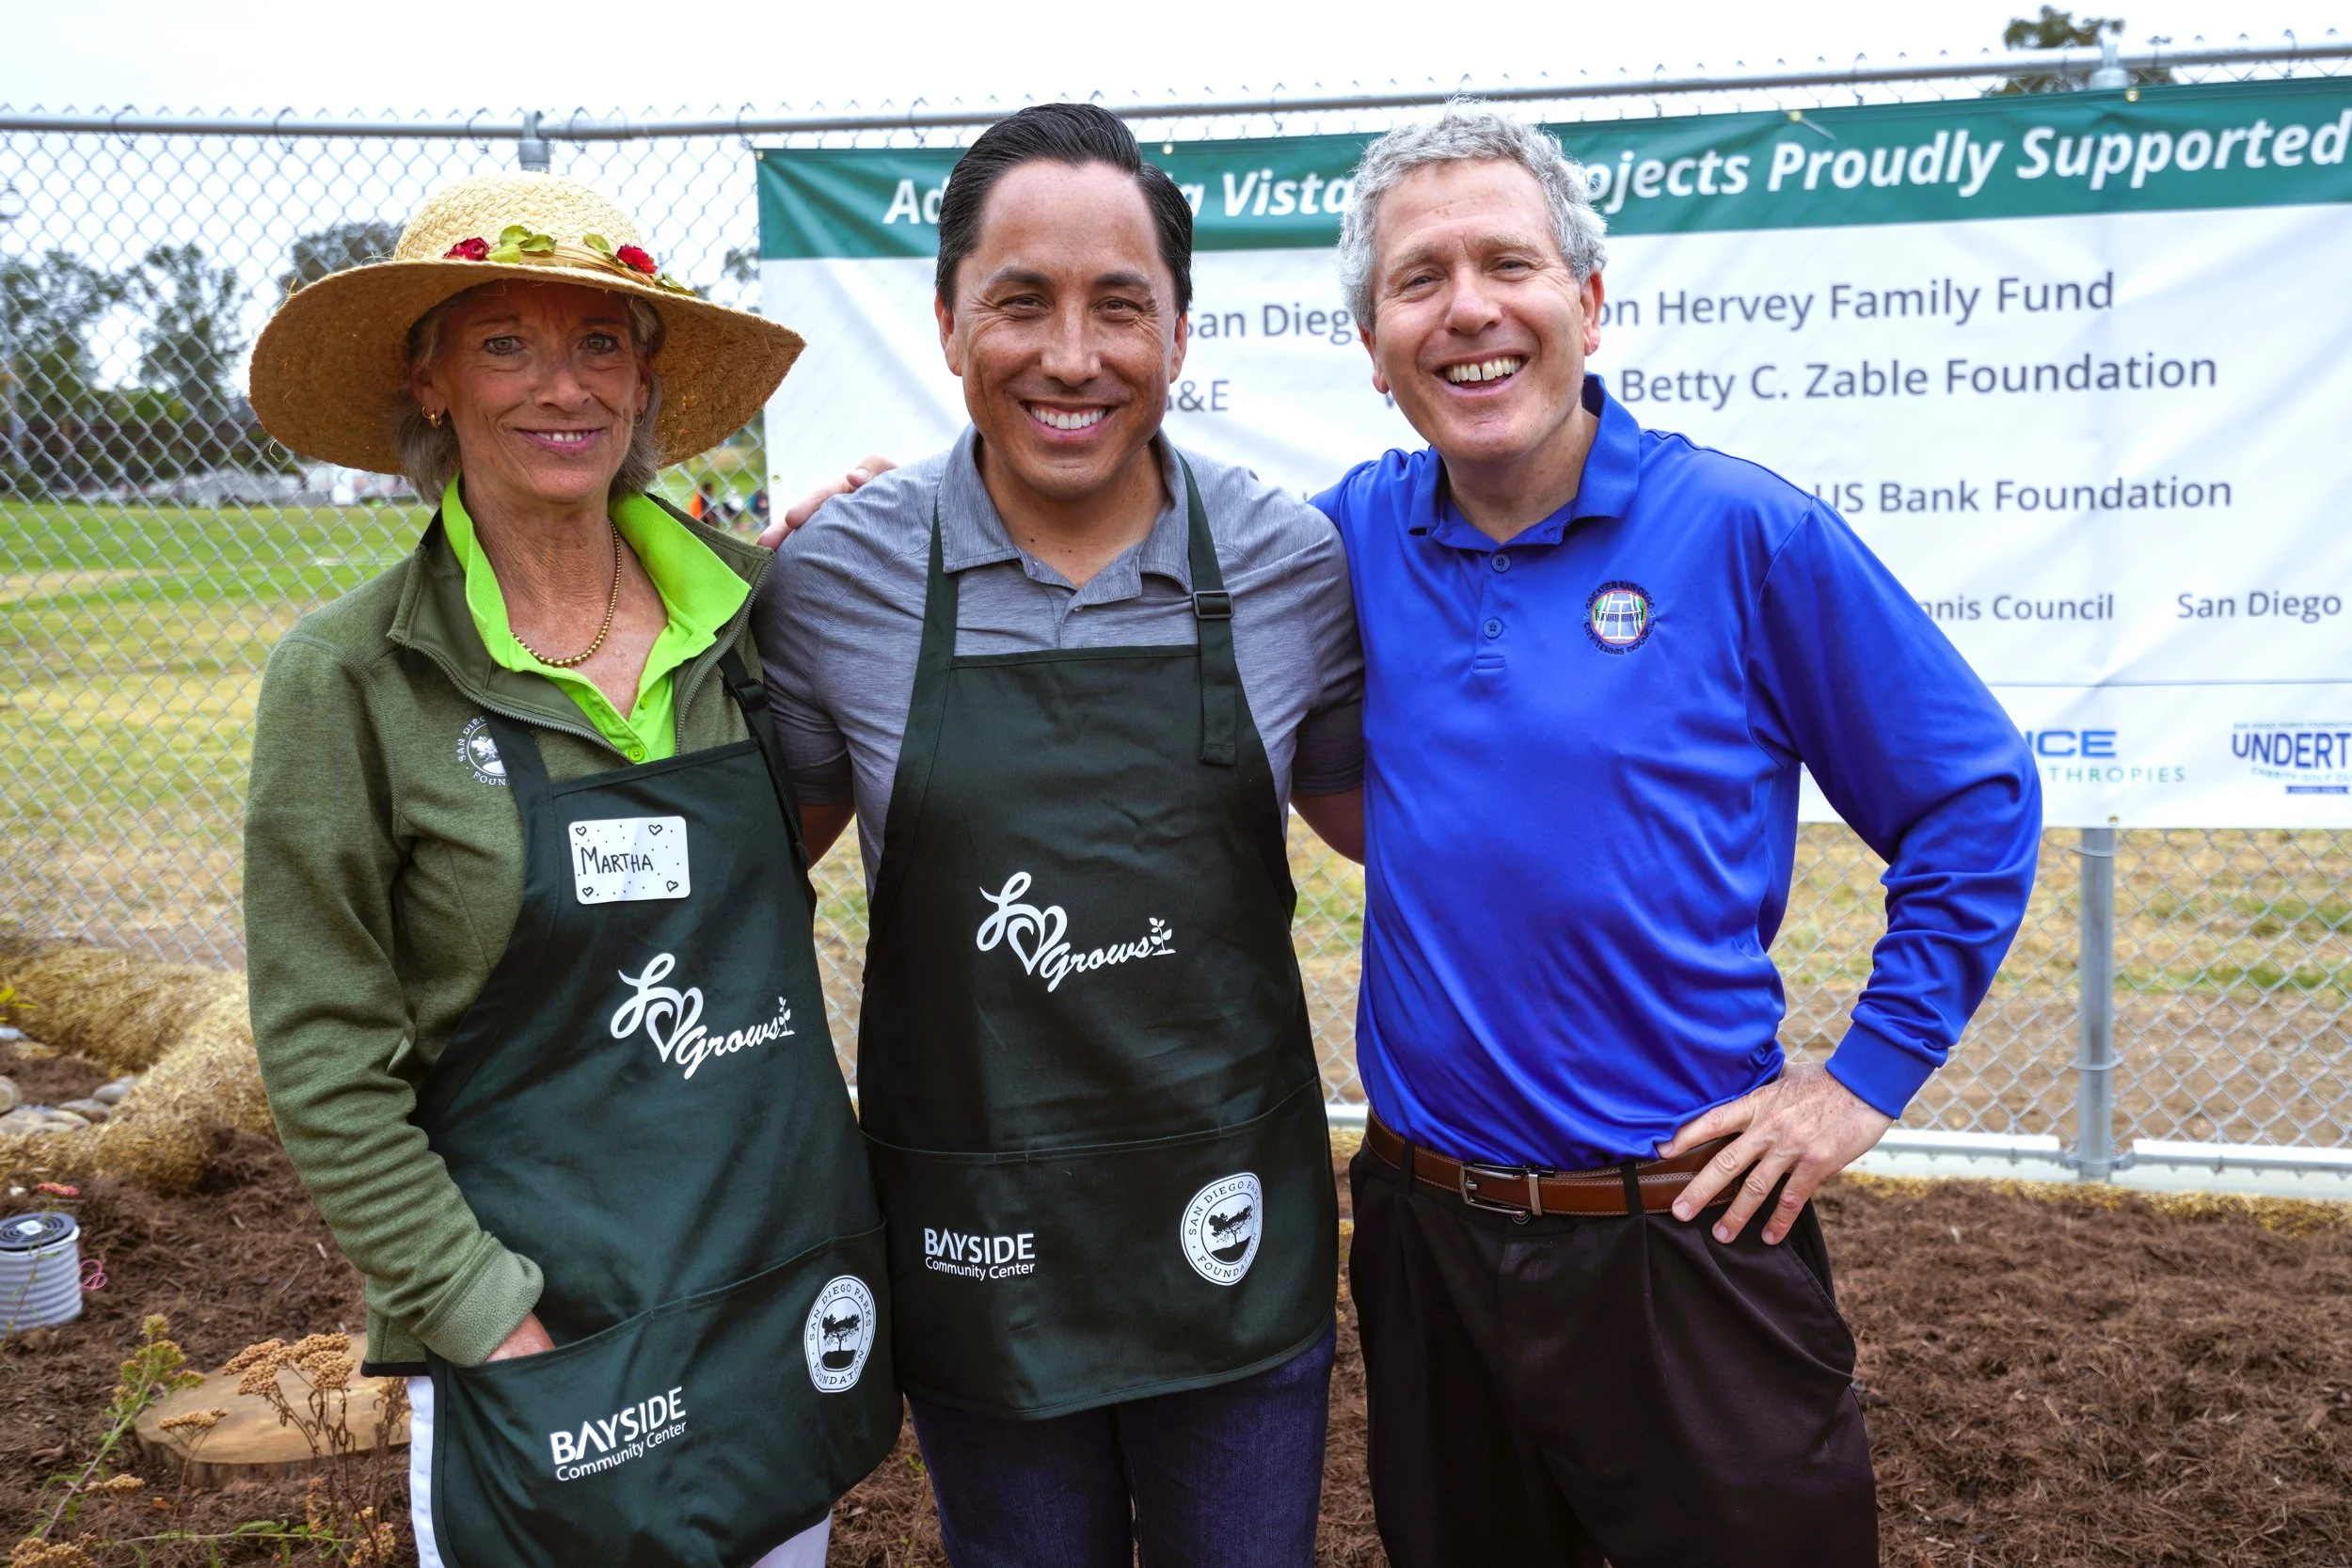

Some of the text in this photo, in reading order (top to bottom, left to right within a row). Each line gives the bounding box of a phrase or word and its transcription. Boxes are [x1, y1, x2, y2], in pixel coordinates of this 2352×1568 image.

[1222, 168, 1355, 217] Vista
[1584, 148, 1751, 215] ojects
[1767, 128, 2005, 198] Proudly
[2015, 108, 2352, 191] Supported
[1658, 291, 1815, 331] Hervey
[1829, 278, 1981, 327] Family
[1996, 271, 2115, 313] Fund
[1262, 302, 1353, 346] Dieg
[1620, 351, 2217, 411] Betty C. Zable Foundation
[1880, 479, 1980, 514] Bank
[1994, 475, 2233, 512] Foundation
[1585, 580, 1618, 610] GREATER
[1993, 593, 2115, 621] Council
[2176, 590, 2343, 624] San Diego
[1595, 641, 1625, 655] TENNIS
[2232, 732, 2352, 770] UNDERT
[473, 770, 510, 786] FOUN
[2046, 766, 2185, 783] THROPIES
[580, 846, 654, 876] MARTHA
[1189, 1206, 1204, 1236] SAN
[1203, 1180, 1245, 1204] DIEGO
[924, 1227, 1036, 1265] BAYSIDE
[925, 1256, 1036, 1281] Community Center
[809, 1283, 872, 1341] SAN DIEGO PARKS
[813, 1350, 865, 1386] FOUNDATION
[549, 1386, 687, 1465] BAYSIDE
[556, 1421, 687, 1481] Community Center
